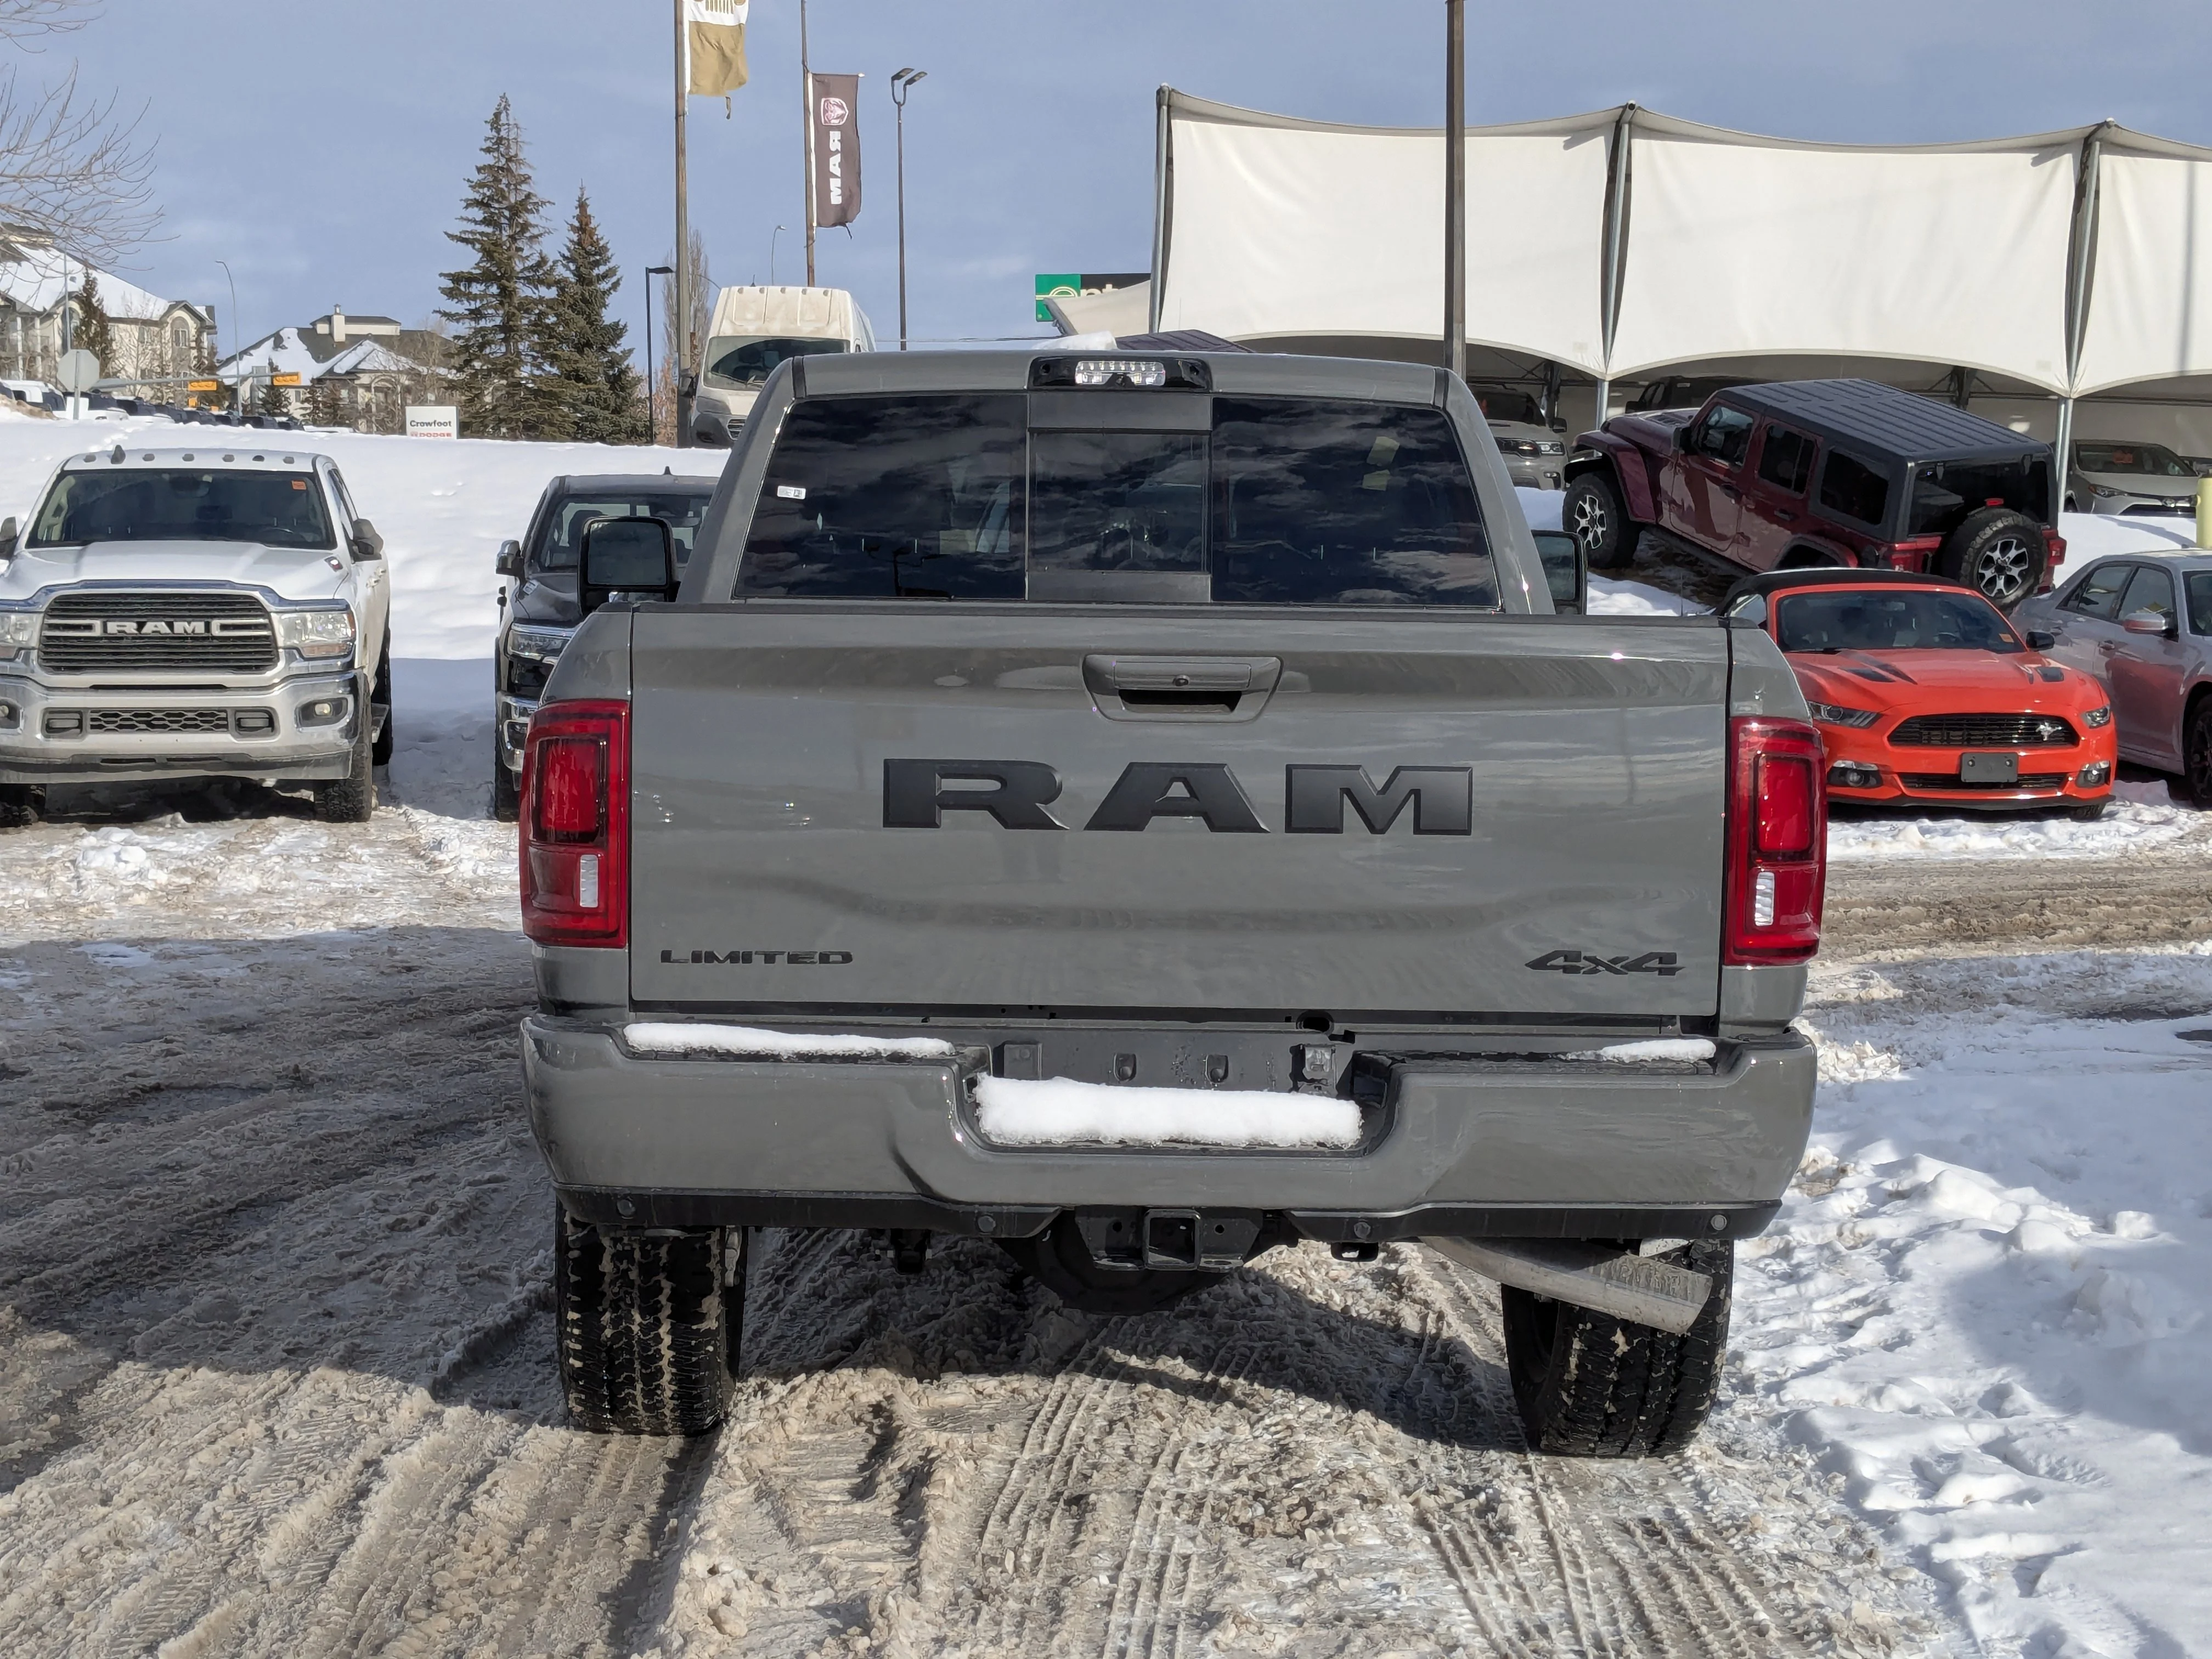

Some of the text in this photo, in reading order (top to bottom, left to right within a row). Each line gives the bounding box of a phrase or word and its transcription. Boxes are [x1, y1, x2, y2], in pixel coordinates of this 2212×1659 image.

[106, 620, 205, 634] RAM
[882, 758, 1473, 836] RAM
[660, 950, 853, 964] LIMITED
